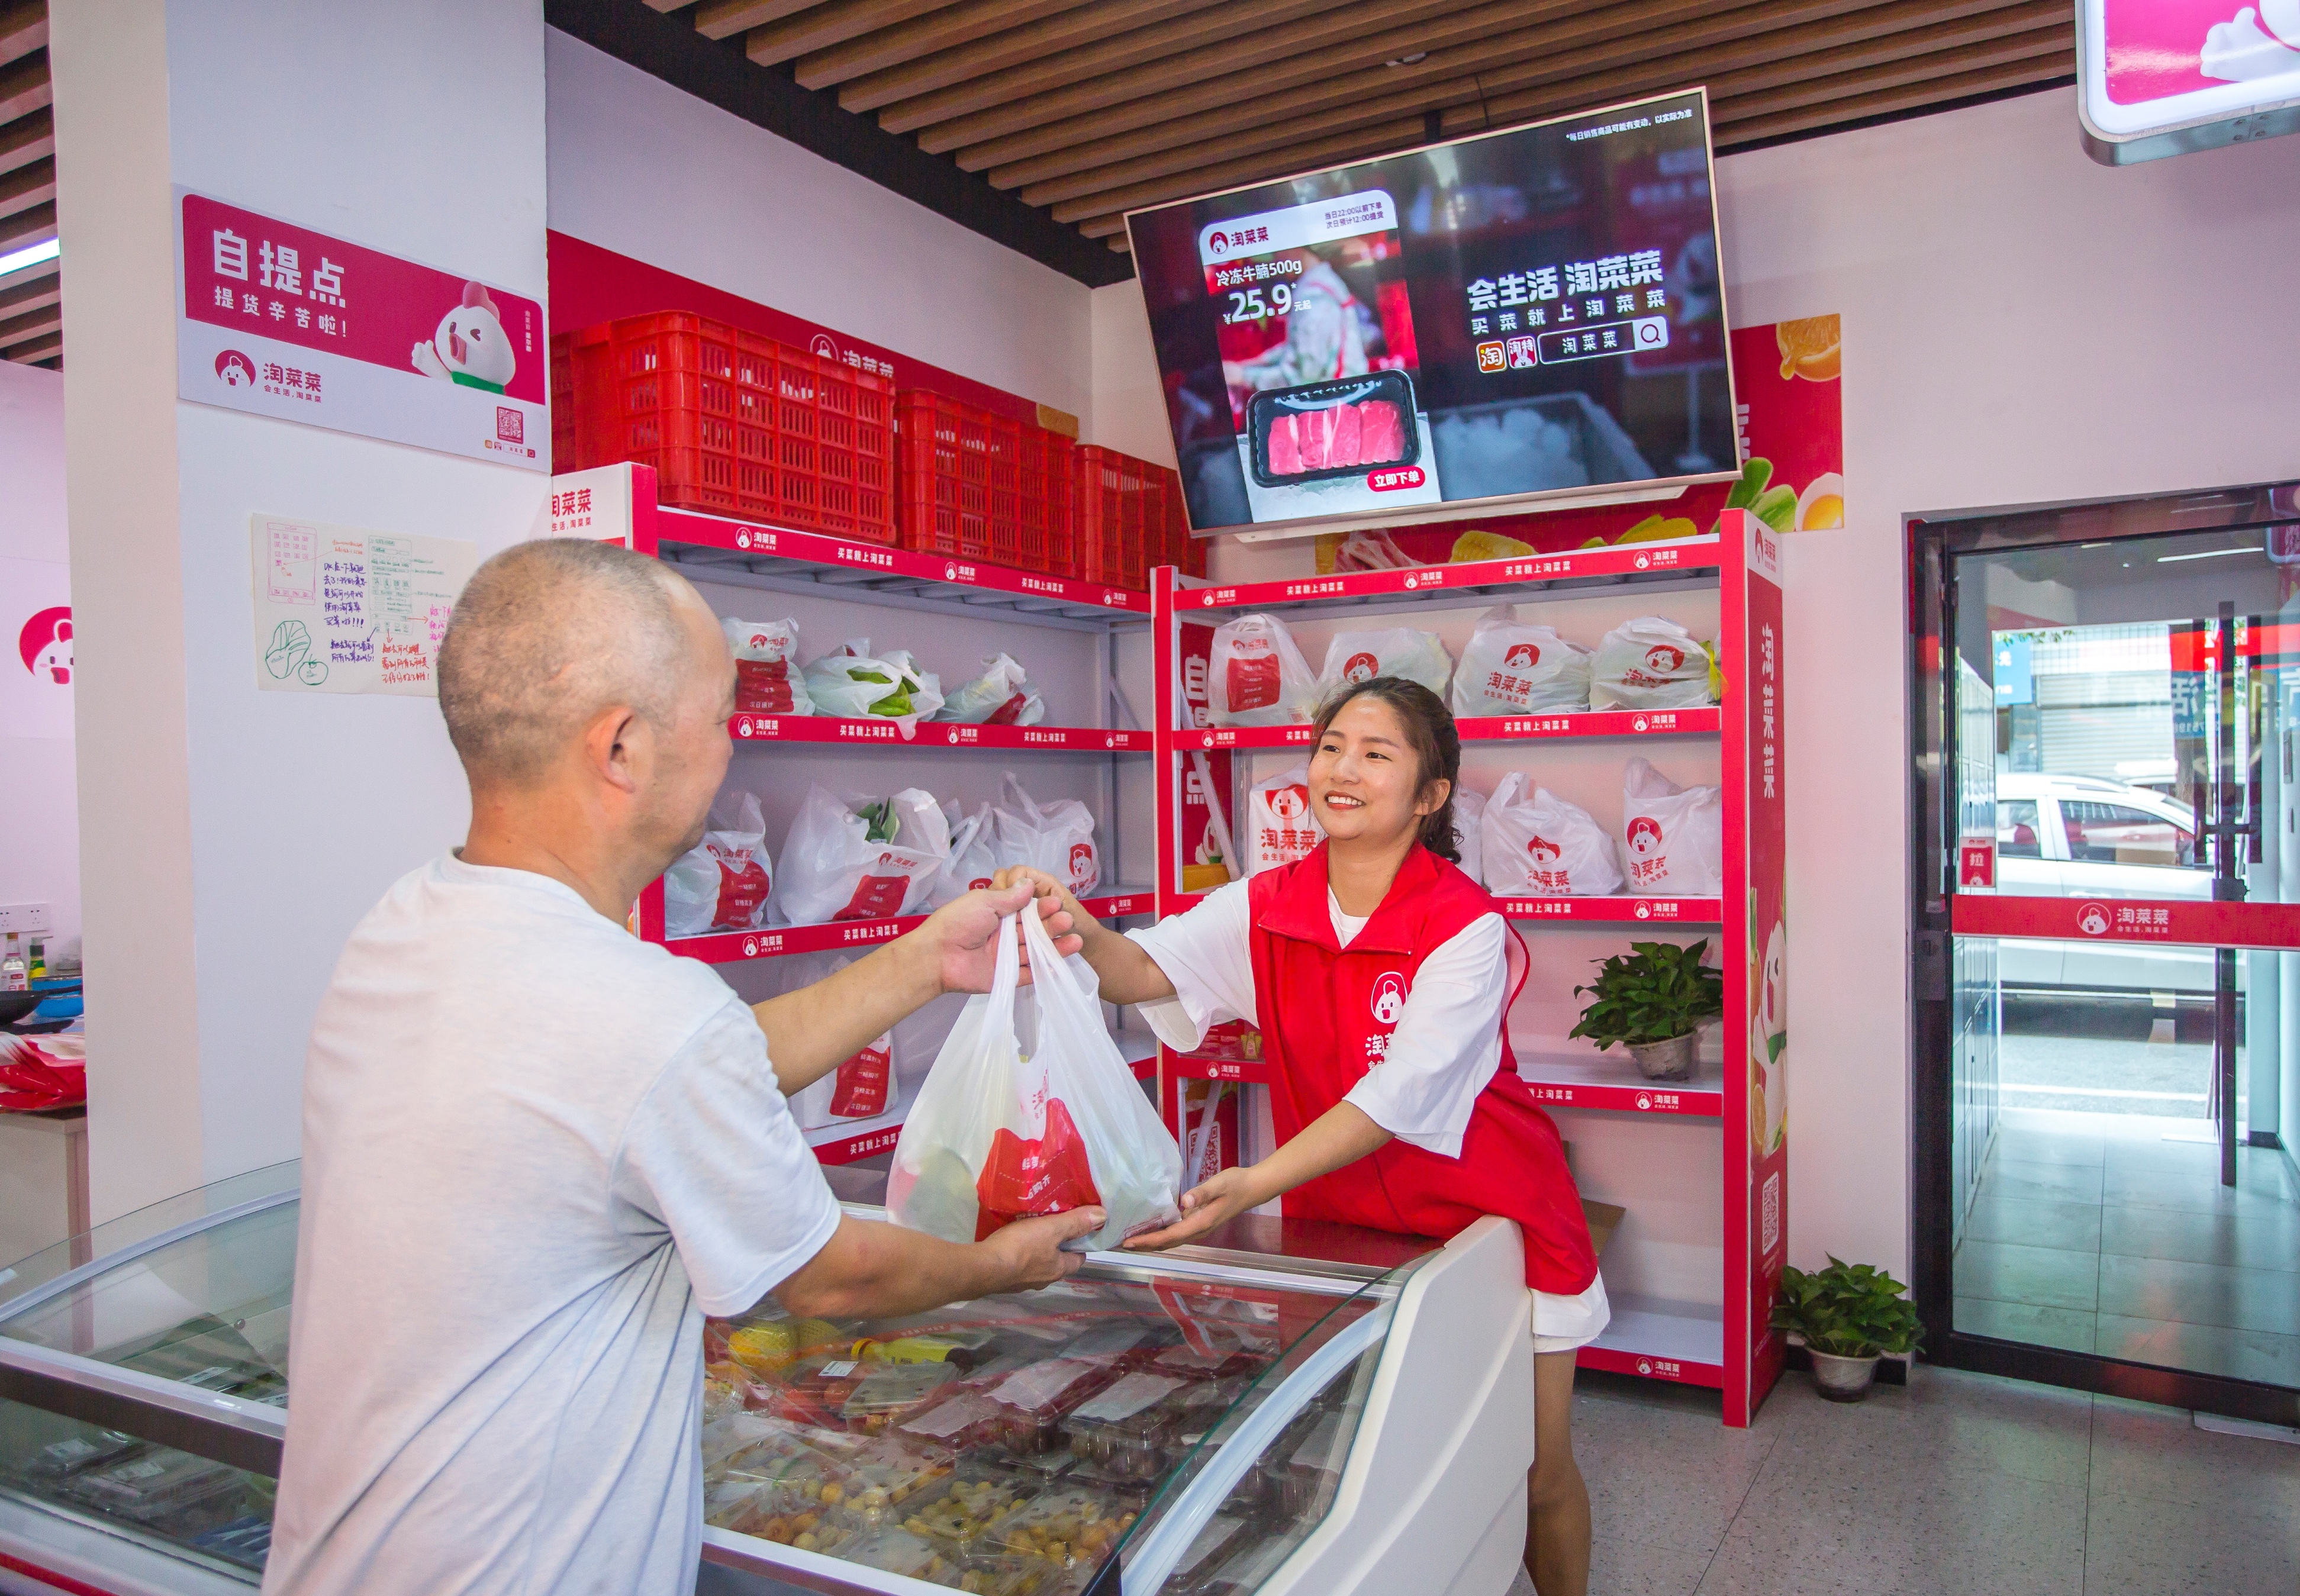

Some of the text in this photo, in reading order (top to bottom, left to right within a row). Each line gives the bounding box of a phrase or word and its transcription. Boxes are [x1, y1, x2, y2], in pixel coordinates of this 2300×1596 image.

[1324, 201, 1383, 221] 当日22:00以前下单
[1230, 226, 1270, 247] 淘菜菜
[214, 228, 346, 308] 自提点
[1214, 257, 1303, 287] 冷冻牛腩500g
[1467, 249, 1664, 312] 会生活 淘菜菜
[214, 286, 347, 337] 提货辛苦啦！
[1293, 299, 1312, 312] 元起
[1471, 288, 1667, 336] 买菜就上淘菜菜
[1509, 338, 1535, 355] 淘特
[1561, 330, 1619, 354] 淘菜菜
[1480, 346, 1503, 367] 淘
[263, 362, 321, 395] 淘菜菜
[1374, 469, 1420, 489] 立即下单
[753, 531, 777, 546] 淘菜菜
[837, 547, 893, 566] 买菜就上淘菜菜
[1652, 550, 1678, 562] 淘菜菜
[958, 565, 975, 578] 淘菜菜
[1505, 560, 1571, 576] 买菜就上淘菜菜
[1021, 577, 1064, 594] 买菜就上淘菜菜
[1420, 571, 1442, 583] 淘菜菜
[1286, 581, 1344, 596] 买菜就上淘菜菜
[1487, 670, 1534, 697] 淘菜菜
[1761, 621, 1775, 799] 淘菜菜
[756, 719, 778, 730] 淘菜菜
[1504, 720, 1570, 732] 买菜就上淘菜菜
[1651, 714, 1676, 724] 淘菜菜
[839, 725, 895, 739] 买菜就上淘菜菜
[960, 728, 978, 738] 淘菜菜
[1024, 731, 1066, 743] 买菜就上淘菜菜
[1260, 827, 1317, 851] 淘菜菜
[1969, 852, 1985, 868] 拉
[1506, 902, 1571, 914] 买菜就上淘菜菜
[1653, 902, 1678, 915] 淘菜菜
[2117, 908, 2169, 925] 淘菜菜
[843, 924, 899, 941] 买菜就上淘菜菜
[759, 934, 783, 950] 淘菜菜
[1654, 1094, 1679, 1108] 淘菜菜
[849, 1131, 901, 1156] 买菜就上淘菜
[1655, 1361, 1680, 1375] 淘菜菜
